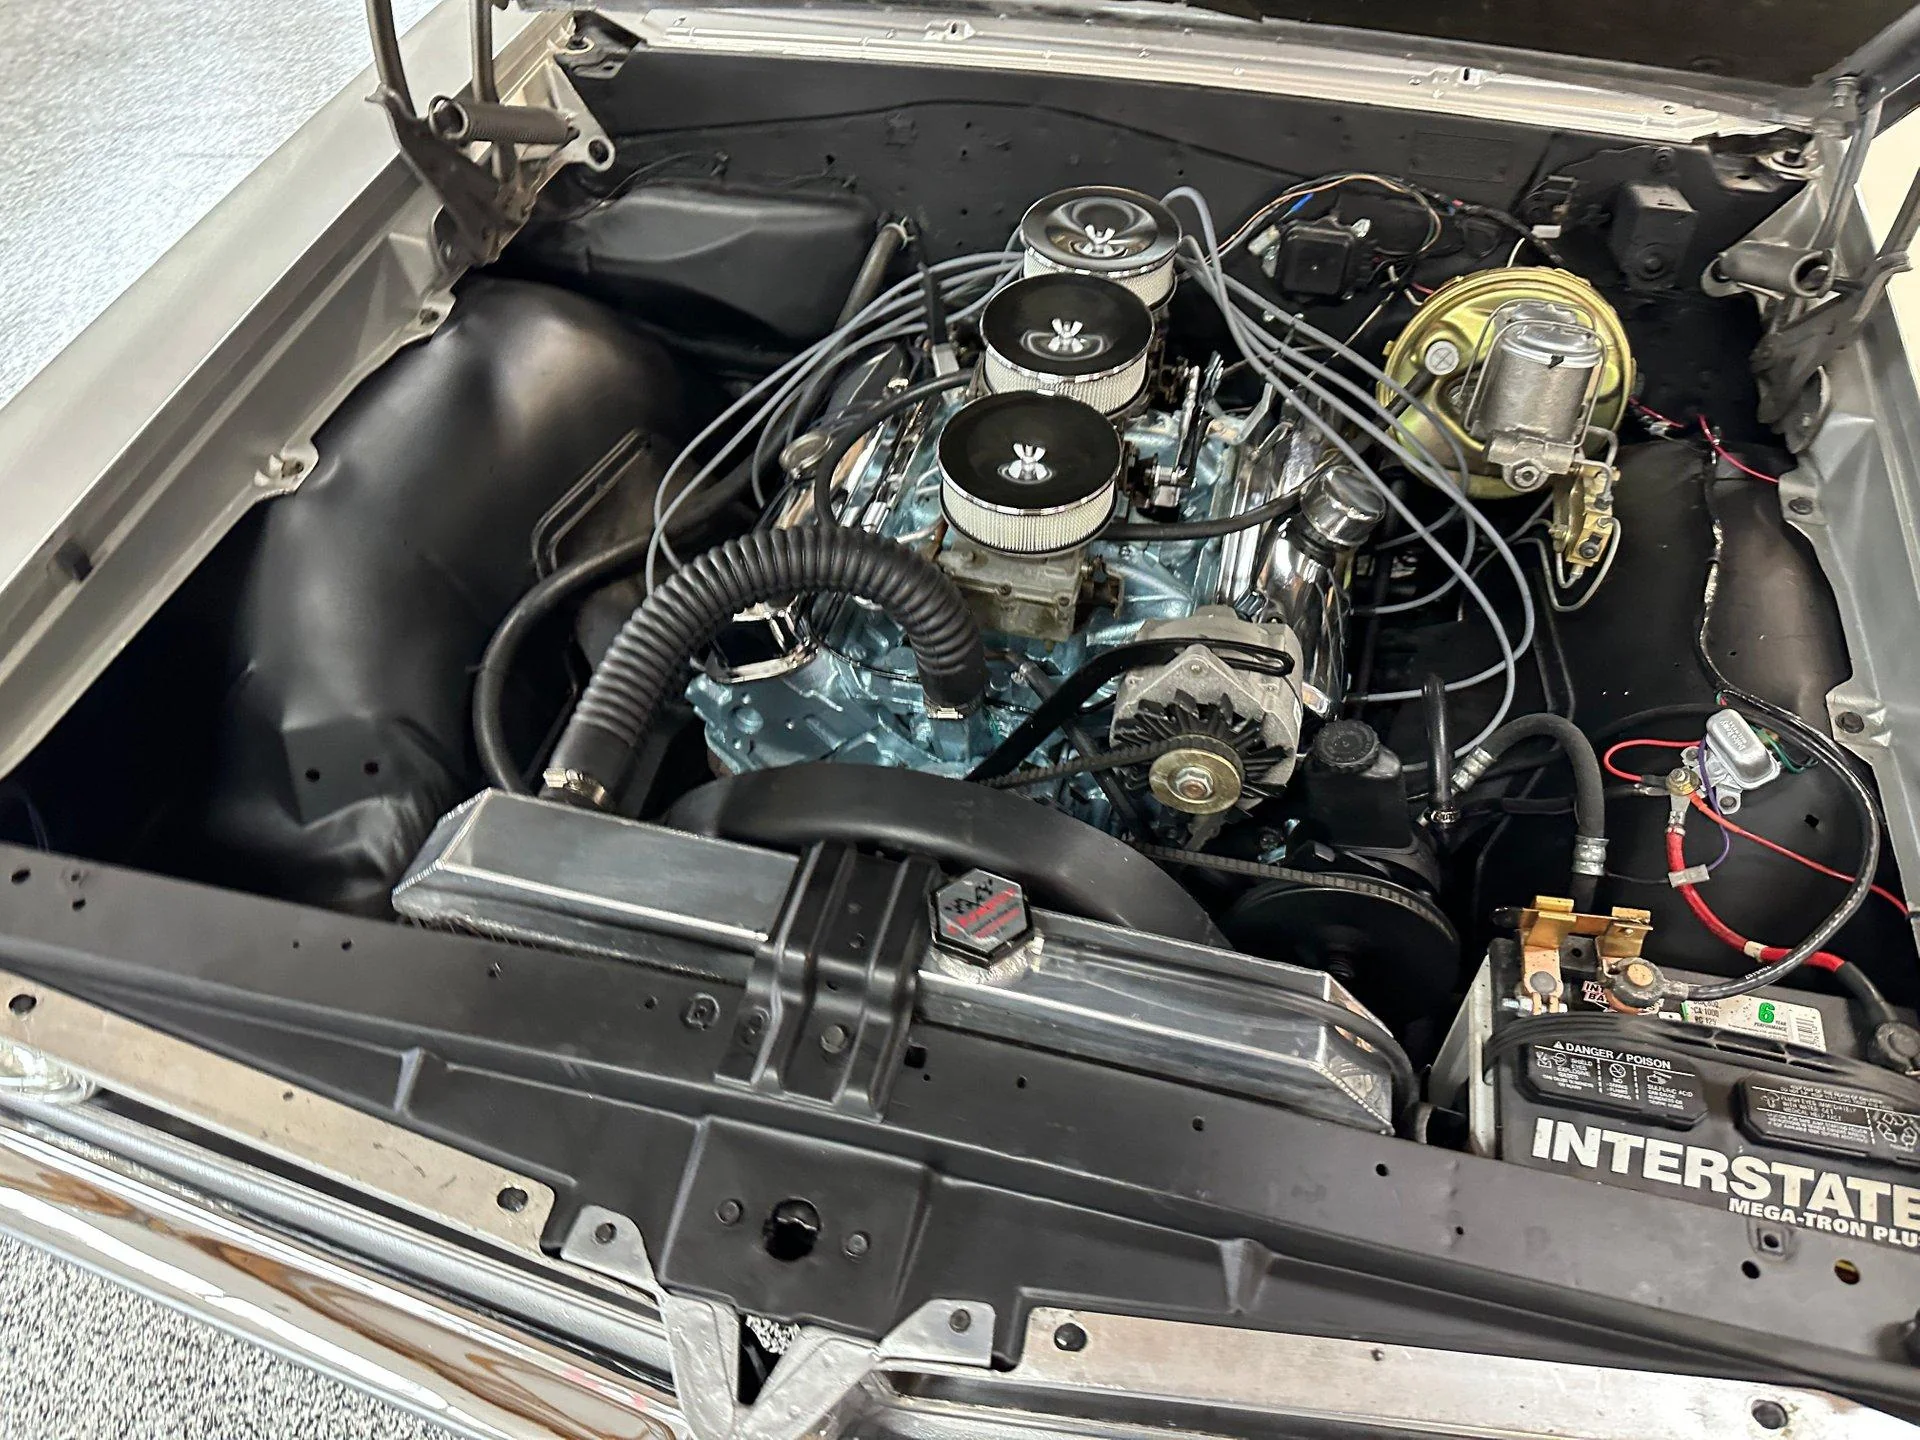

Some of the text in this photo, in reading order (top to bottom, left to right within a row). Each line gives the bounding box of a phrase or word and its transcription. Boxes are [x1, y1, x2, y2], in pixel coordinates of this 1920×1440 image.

[1757, 1002, 1776, 1024] 6
[1566, 1043, 1614, 1059] DANGER
[1626, 1054, 1671, 1070] POISON
[1531, 1117, 1920, 1230] INTERSTATE
[1728, 1198, 1920, 1248] MEGA-TRON PLU
